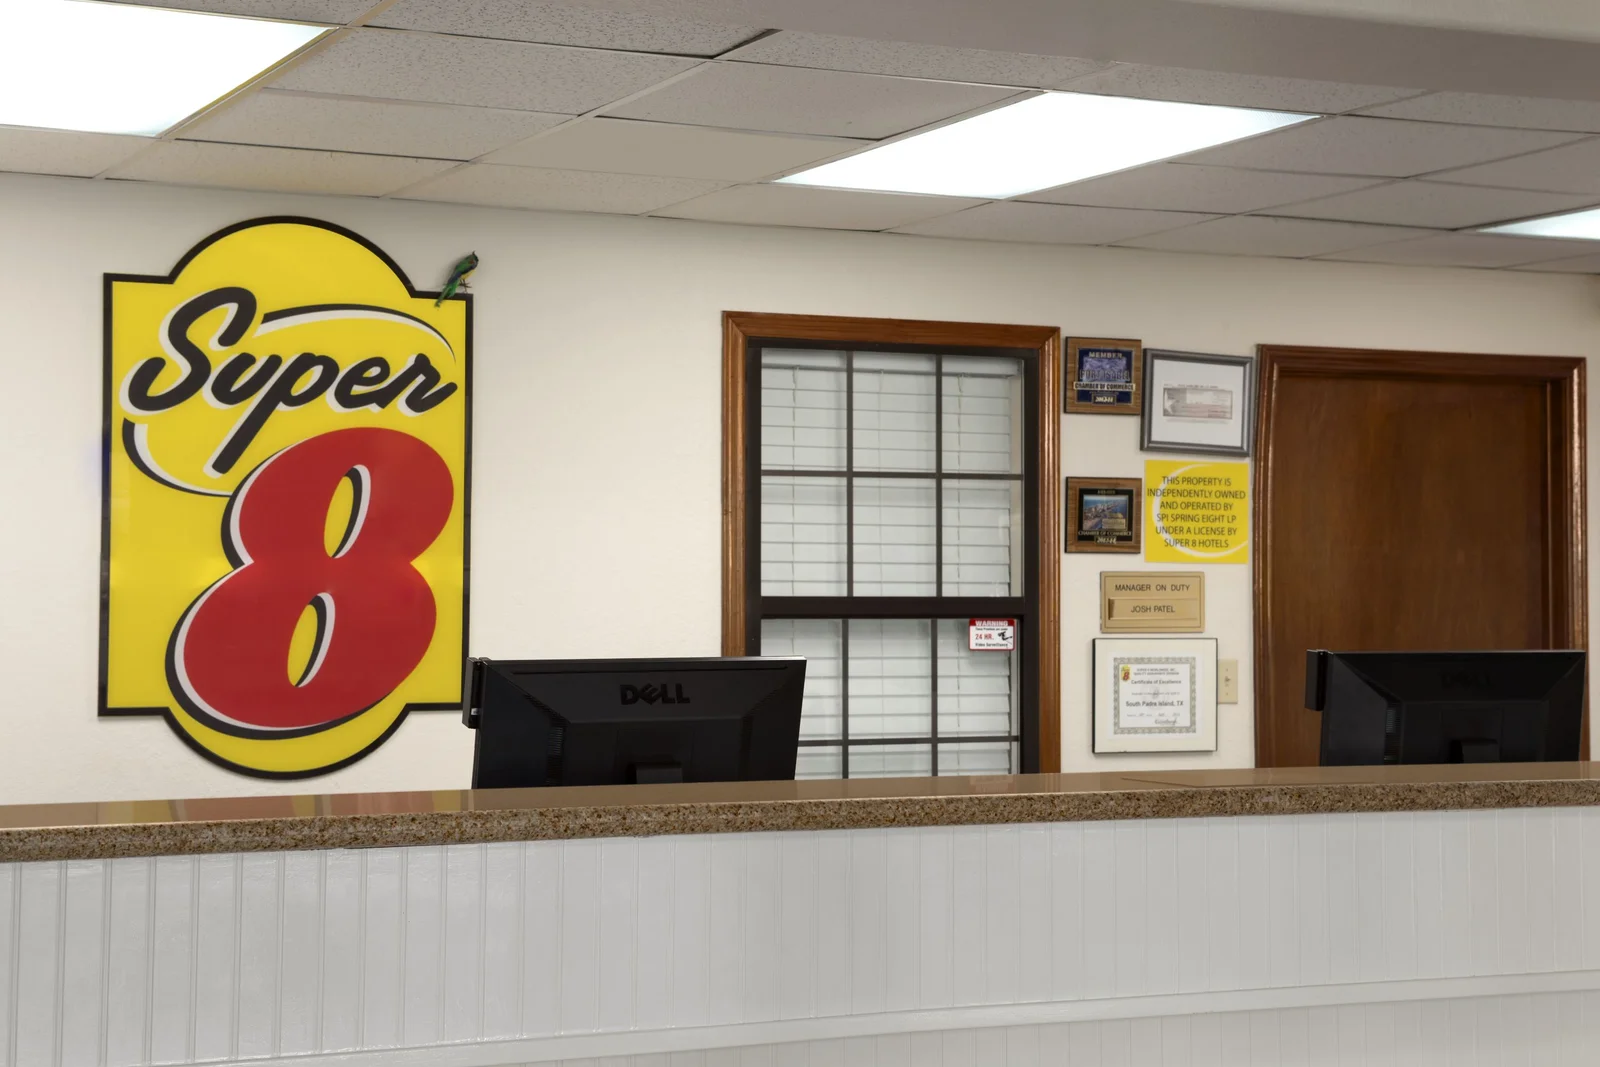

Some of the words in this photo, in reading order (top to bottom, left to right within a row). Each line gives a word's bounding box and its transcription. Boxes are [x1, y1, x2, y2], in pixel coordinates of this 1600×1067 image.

[1088, 351, 1123, 359] MEMBER
[120, 286, 458, 478] Super
[1106, 383, 1134, 391] COMMERCE
[1162, 476, 1180, 485] THIS
[1181, 476, 1223, 486] PROPERTY
[1224, 477, 1232, 486] IS
[1147, 488, 1213, 498] INDEPENDENTLY
[1214, 489, 1246, 499] OWNED
[1160, 501, 1178, 510] AND
[1179, 501, 1222, 511] OPERATED
[1223, 503, 1234, 511] BY
[1156, 513, 1169, 522] SPI
[1170, 514, 1200, 523] SPRING
[1201, 515, 1225, 523] EIGHT
[1227, 515, 1237, 524] LP
[1155, 526, 1184, 535] UNDER
[1185, 526, 1192, 535] A
[1193, 526, 1225, 536] LICENSE
[1227, 527, 1238, 536] BY
[1164, 538, 1190, 547] SUPER
[1191, 539, 1197, 547] 8
[1198, 539, 1229, 548] HOTELS
[167, 426, 454, 738] 8
[1130, 605, 1152, 613] JOSH
[1153, 605, 1175, 613] PATEL
[620, 682, 691, 706] DELL
